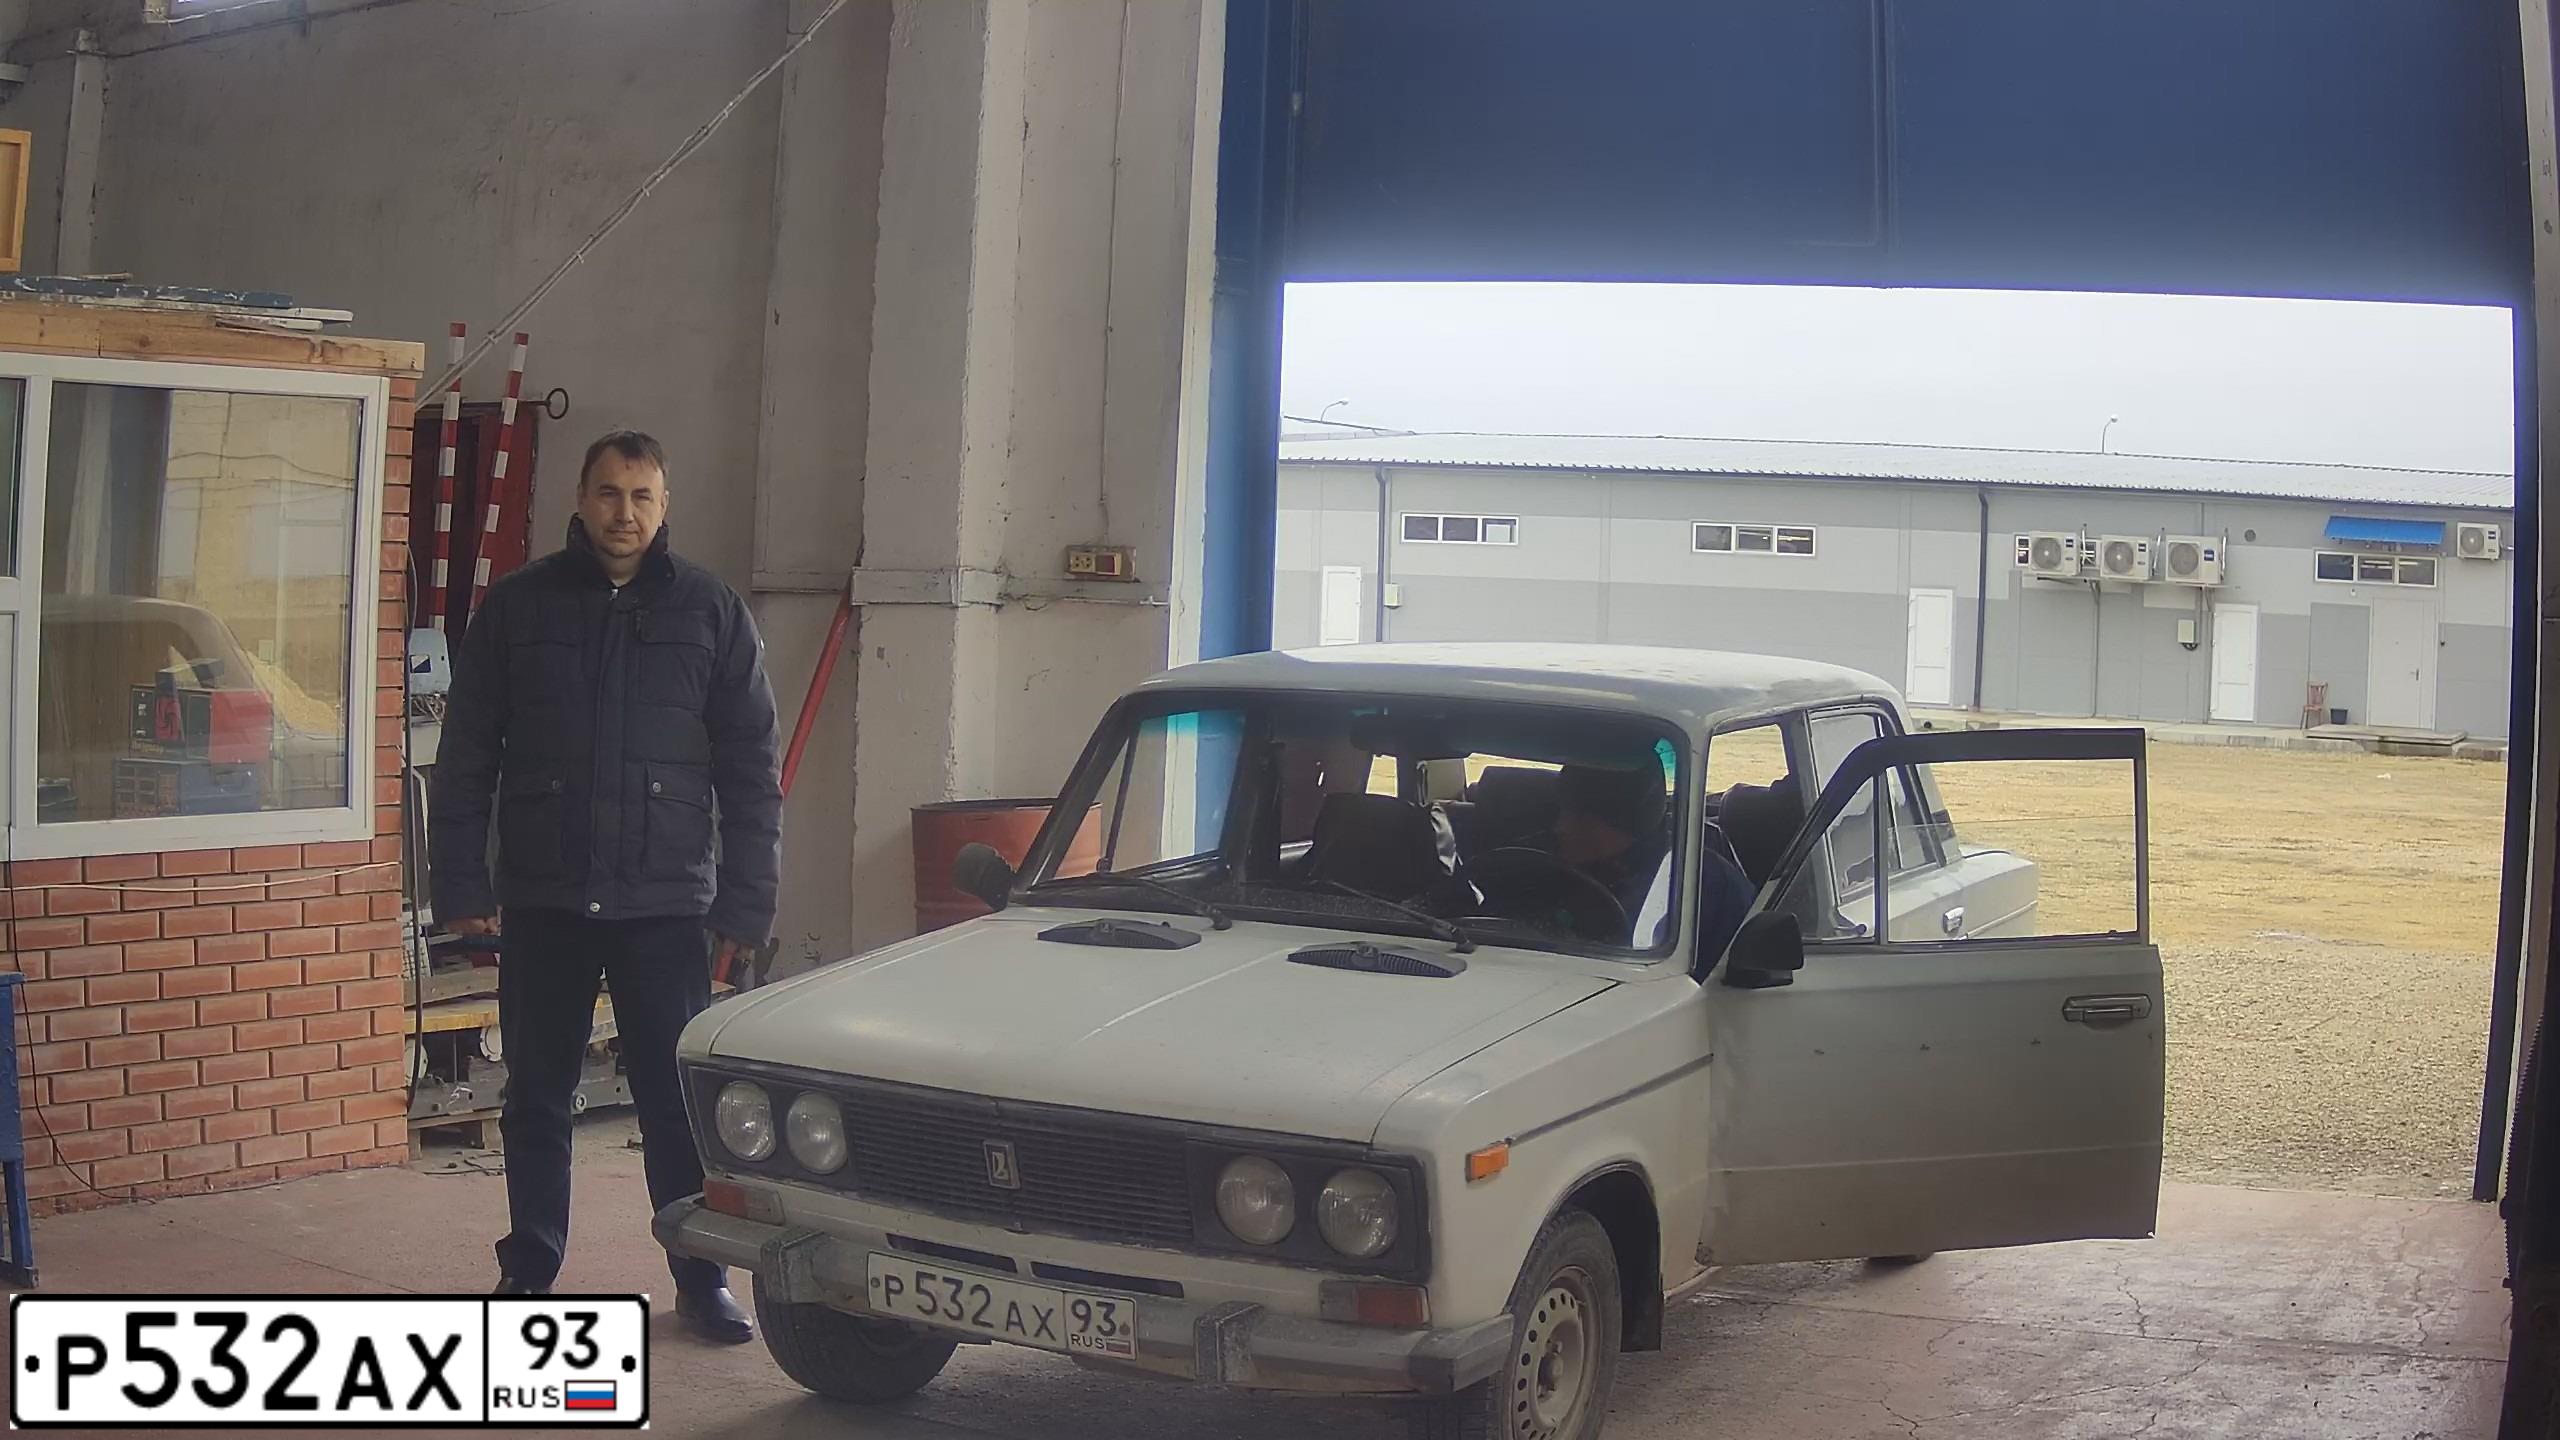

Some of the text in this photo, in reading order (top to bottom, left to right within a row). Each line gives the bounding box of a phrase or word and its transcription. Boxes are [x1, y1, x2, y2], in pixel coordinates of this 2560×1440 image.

[884, 1271, 1116, 1341] P532AX 93
[1070, 1333, 1105, 1350] RUS
